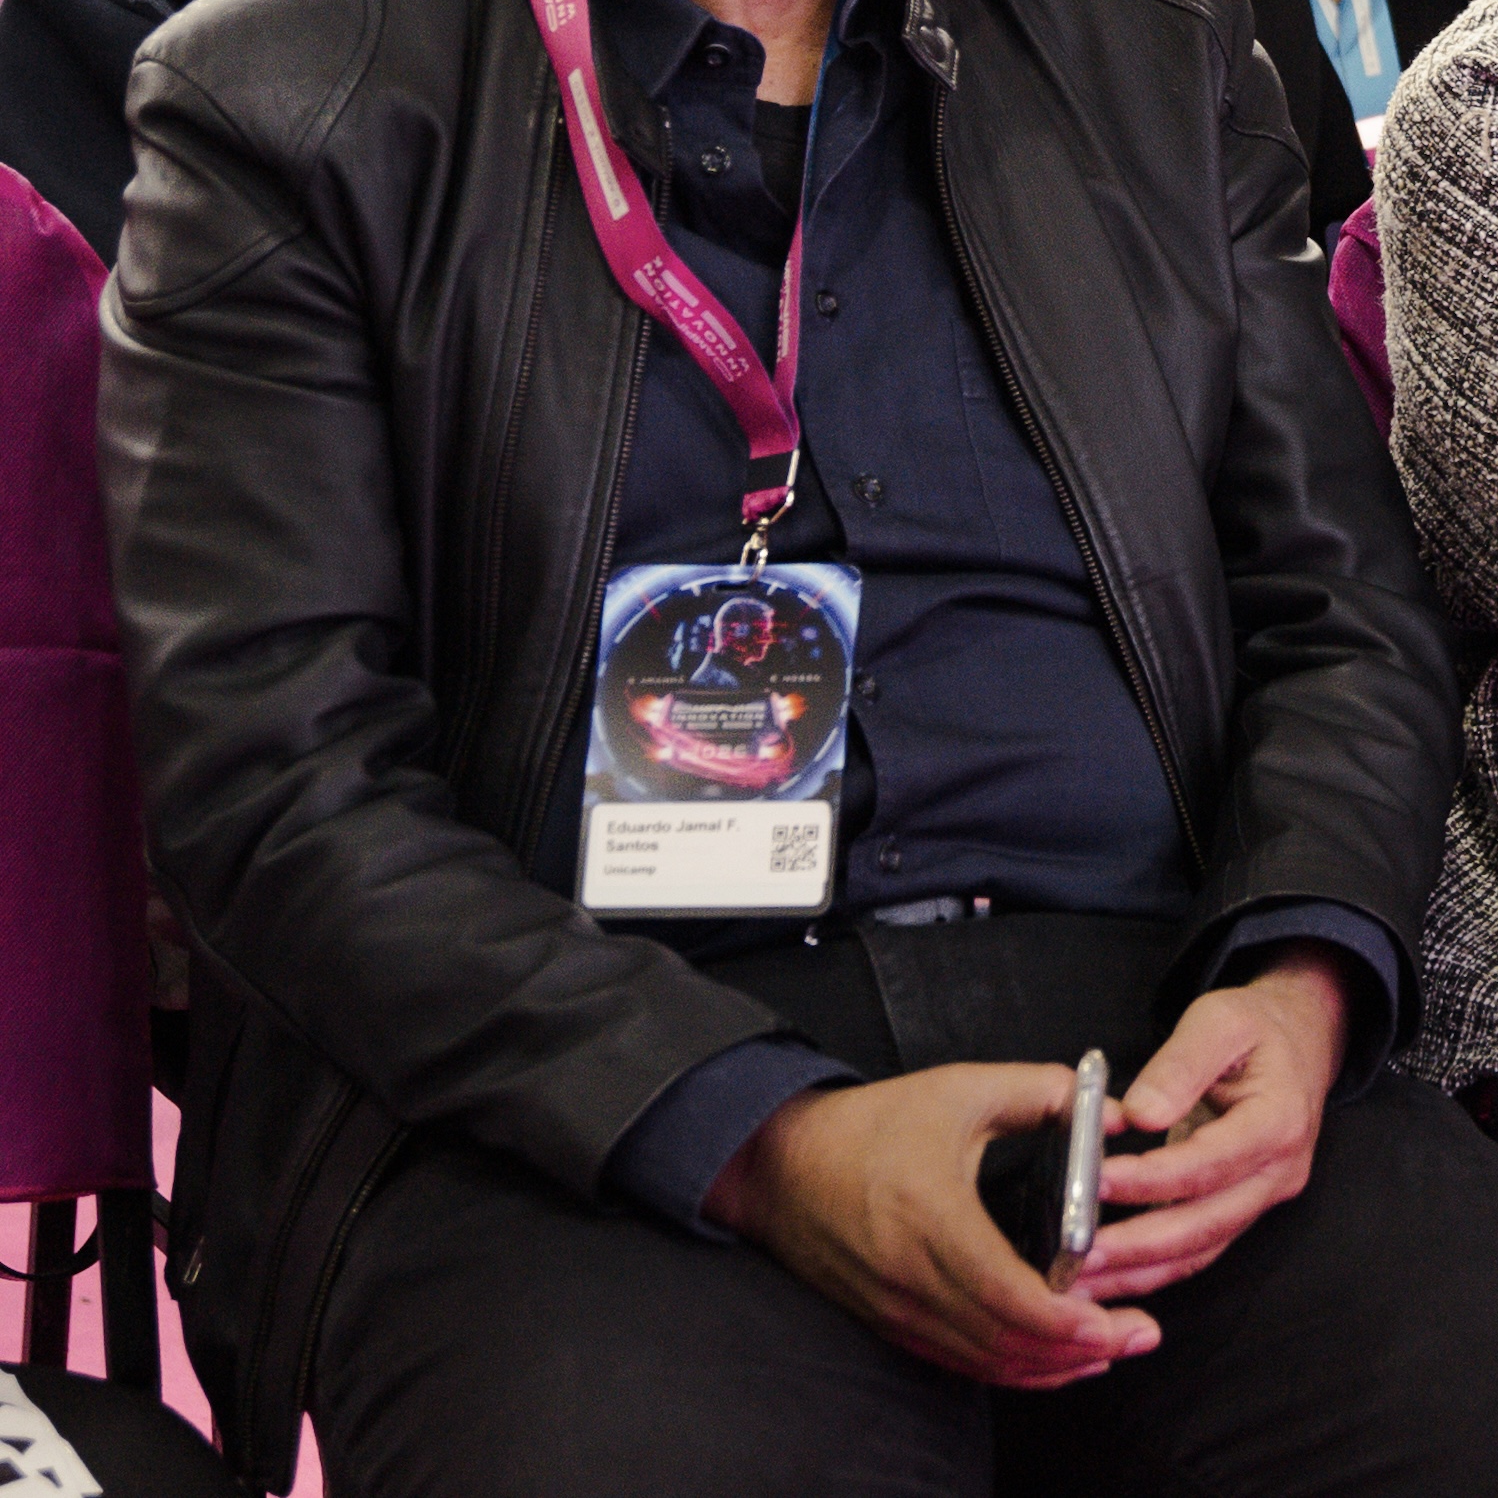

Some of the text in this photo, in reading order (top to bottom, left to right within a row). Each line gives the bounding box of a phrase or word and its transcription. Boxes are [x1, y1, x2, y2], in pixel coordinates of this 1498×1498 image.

[607, 820, 672, 834] Eduardo
[676, 819, 722, 833] Jamal
[606, 840, 660, 852] Santos
